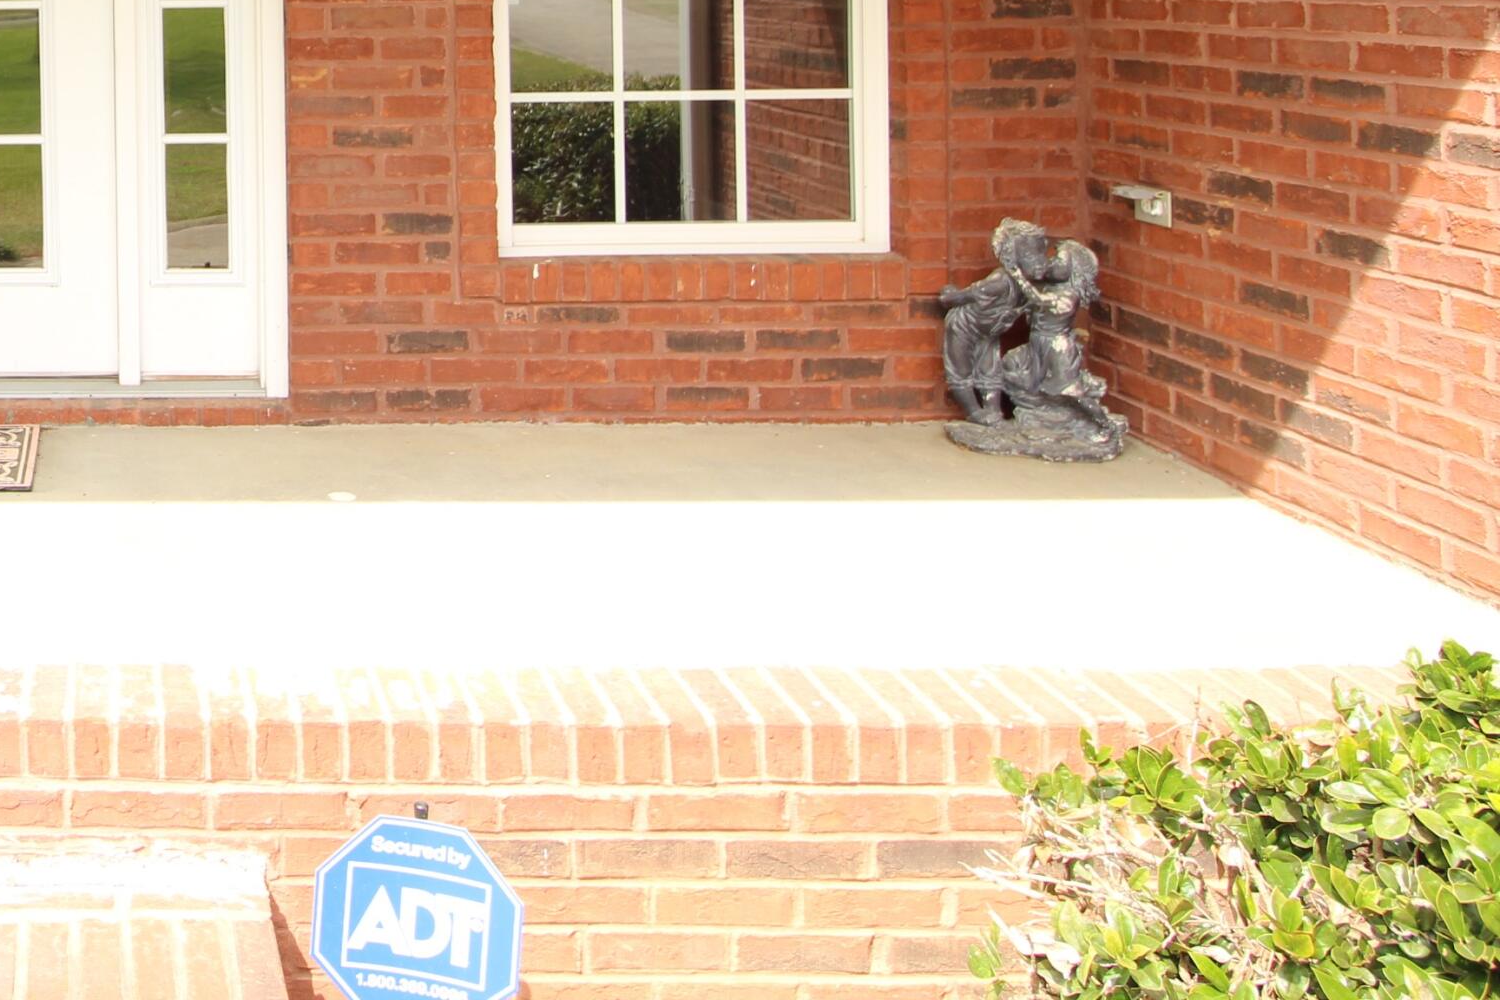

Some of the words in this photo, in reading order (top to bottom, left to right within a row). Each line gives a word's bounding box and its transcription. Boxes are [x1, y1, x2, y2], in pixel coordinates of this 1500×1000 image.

[371, 835, 447, 862] Secured
[448, 846, 472, 870] by
[347, 885, 486, 968] ADT
